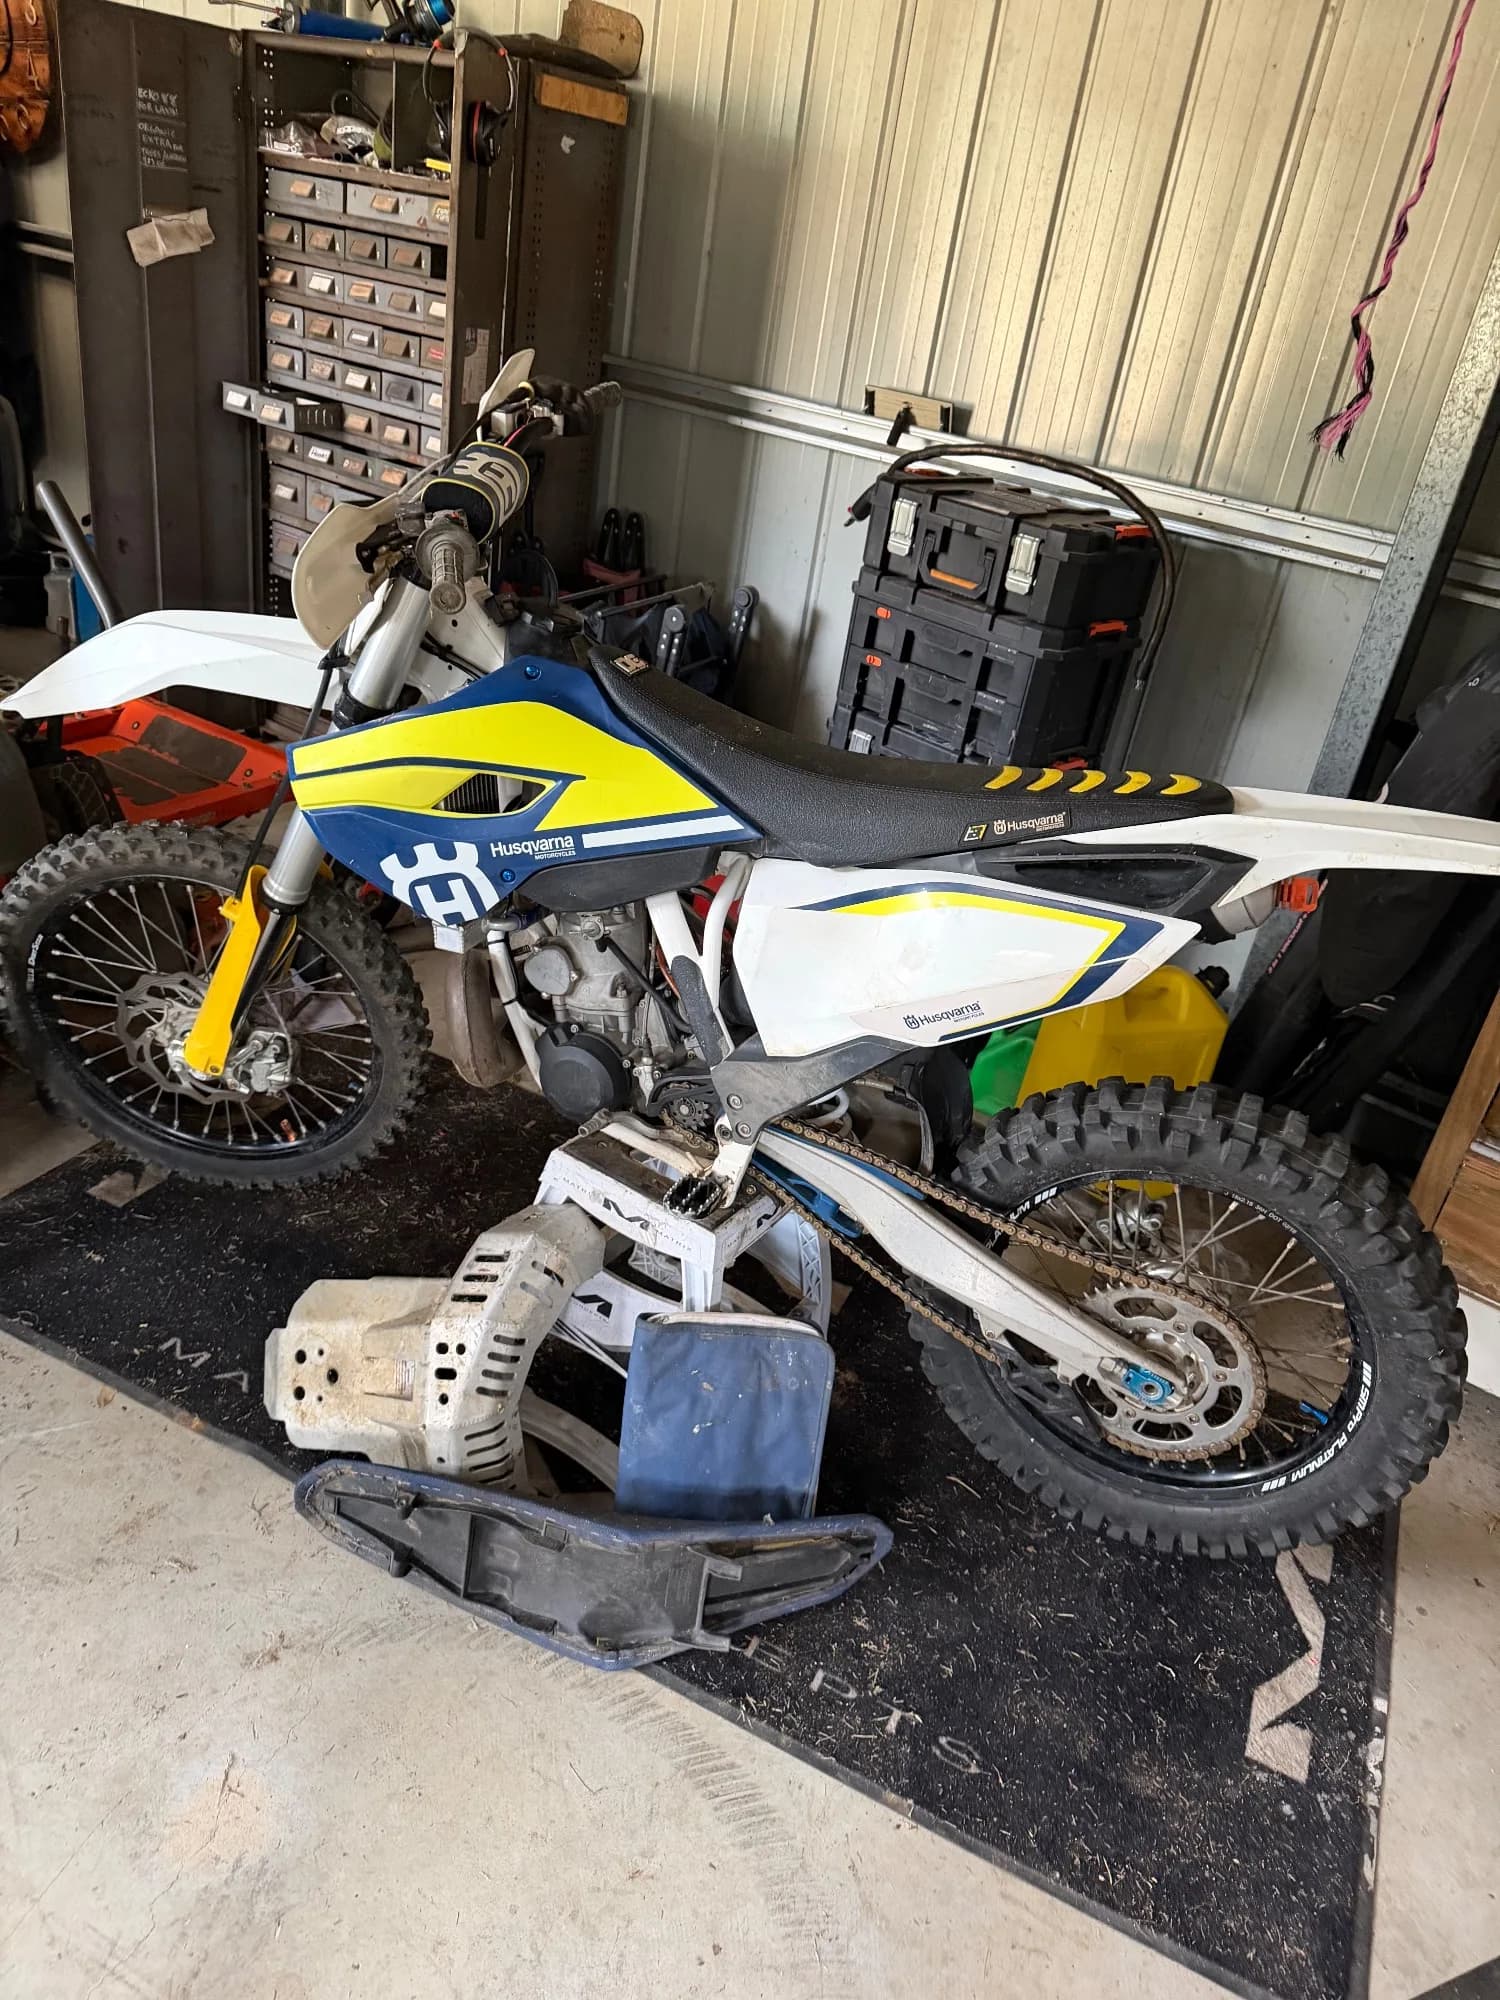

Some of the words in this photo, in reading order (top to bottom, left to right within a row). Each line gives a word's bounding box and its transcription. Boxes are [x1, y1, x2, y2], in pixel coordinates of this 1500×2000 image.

[1007, 812, 1066, 833] Husqvarna
[489, 835, 575, 858] Husqvarna
[534, 850, 577, 861] MOTORCYCLES
[919, 1001, 982, 1026] Husqvarna
[1291, 1431, 1349, 1482] PLATINUM
